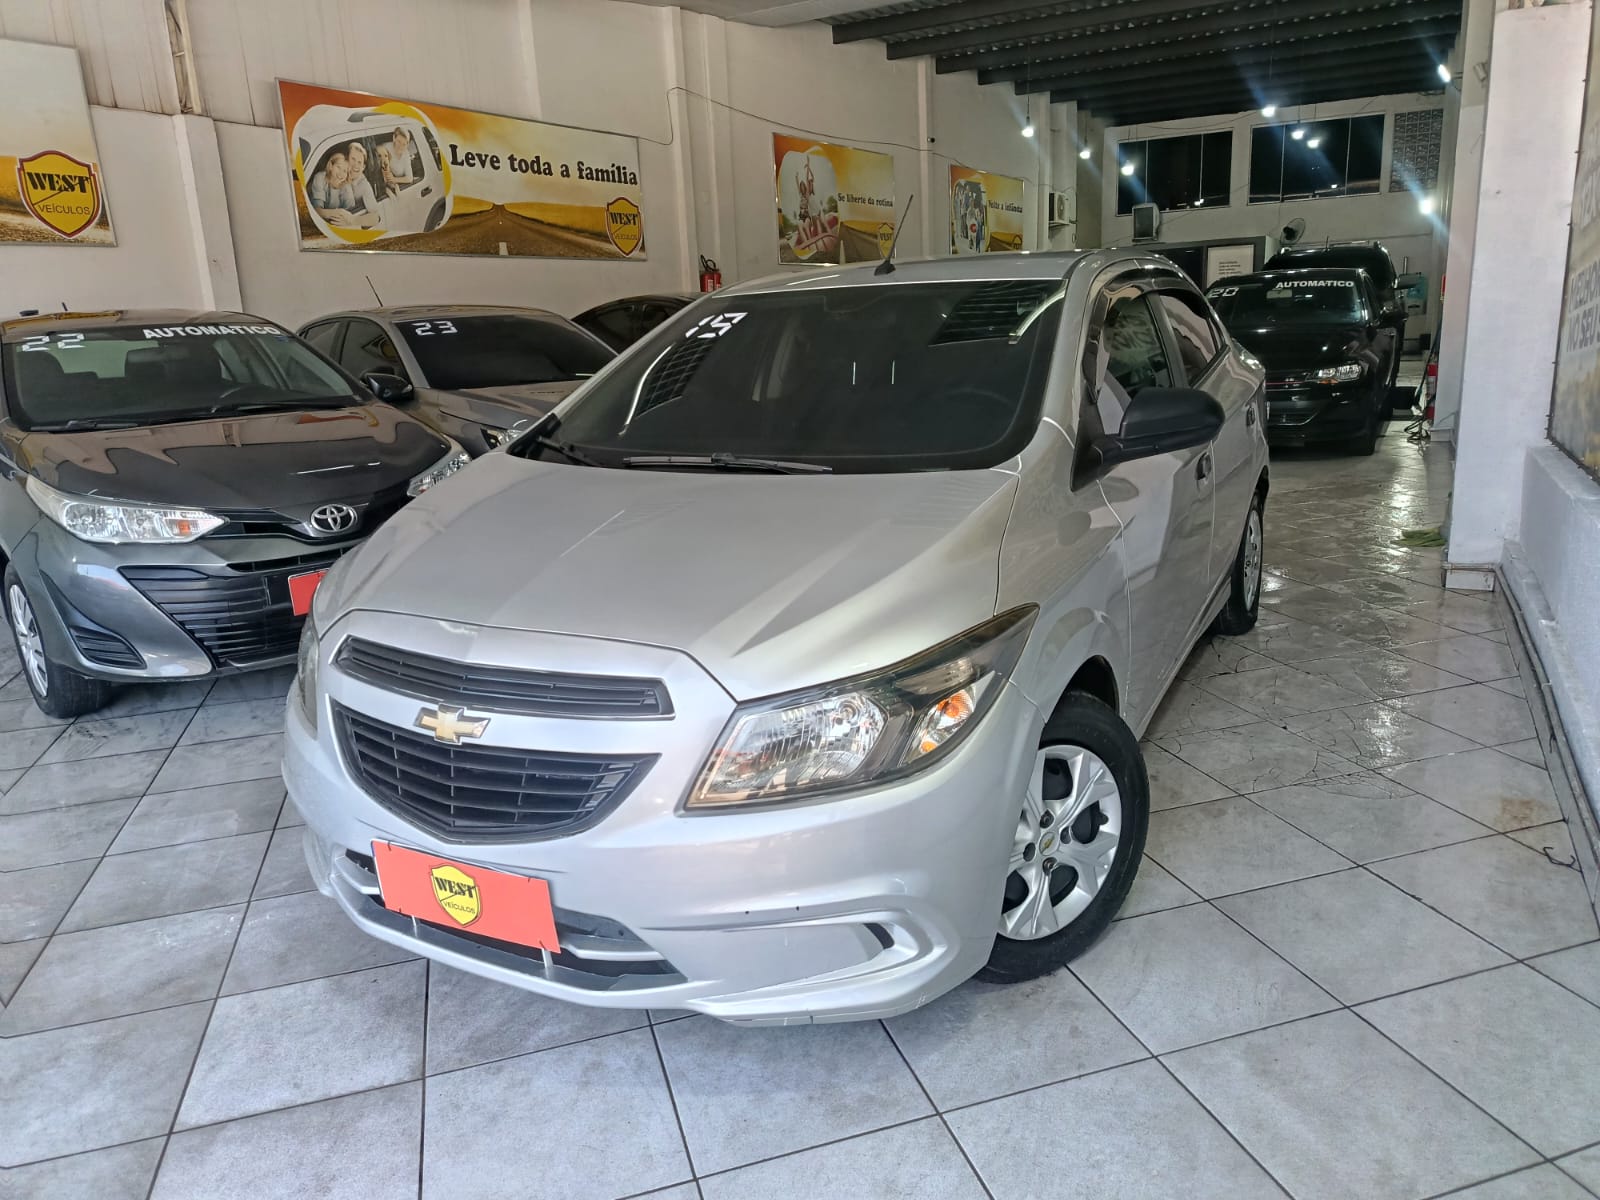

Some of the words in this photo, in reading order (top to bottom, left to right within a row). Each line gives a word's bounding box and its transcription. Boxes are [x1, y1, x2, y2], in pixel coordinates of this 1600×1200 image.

[449, 143, 501, 171] Leve
[507, 153, 554, 177] toda
[560, 163, 571, 178] a
[576, 160, 638, 186] família
[26, 171, 91, 194] WEST
[838, 192, 845, 202] Se
[846, 193, 866, 204] liberte
[867, 197, 875, 205] da
[876, 199, 893, 207] rotina
[38, 203, 91, 216] VEÍCULOS
[610, 212, 638, 226] WEST
[1207, 287, 1240, 298] 20
[411, 320, 458, 336] 23
[685, 312, 748, 338] 19
[22, 333, 86, 352] 22
[434, 876, 477, 899] WEST
